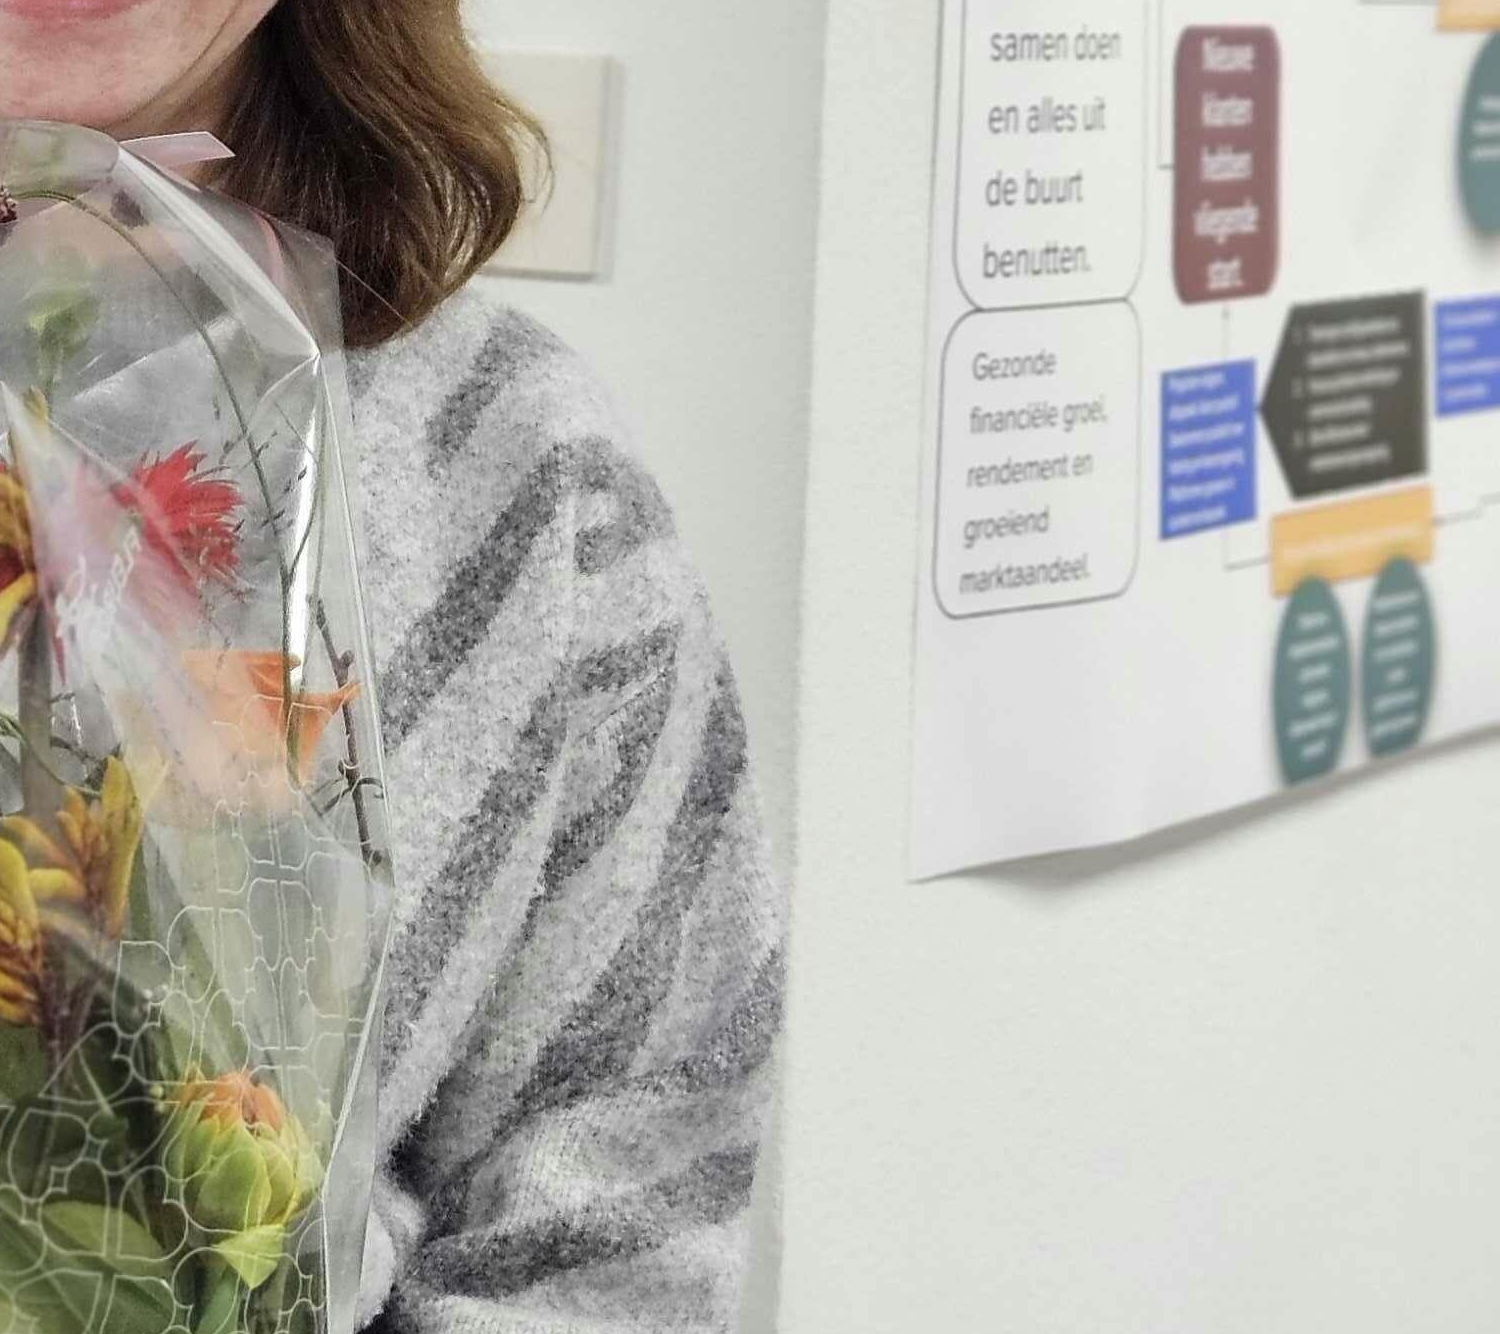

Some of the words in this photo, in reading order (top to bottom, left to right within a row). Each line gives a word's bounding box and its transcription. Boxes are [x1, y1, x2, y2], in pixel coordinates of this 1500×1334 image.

[990, 32, 1068, 62] samen
[1074, 28, 1121, 61] doen
[988, 103, 1019, 134] en
[1027, 97, 1077, 133] alles
[1082, 96, 1106, 131] uit
[985, 171, 1018, 207] de
[1024, 171, 1083, 204] buurt
[982, 243, 1092, 279] benutten.
[972, 349, 1057, 381] Gezonde
[969, 400, 1059, 435] financiële
[966, 454, 1069, 488] rendement
[1073, 453, 1094, 478] en
[963, 504, 1050, 549] groeiend
[959, 553, 1090, 595] marktaandeel.
